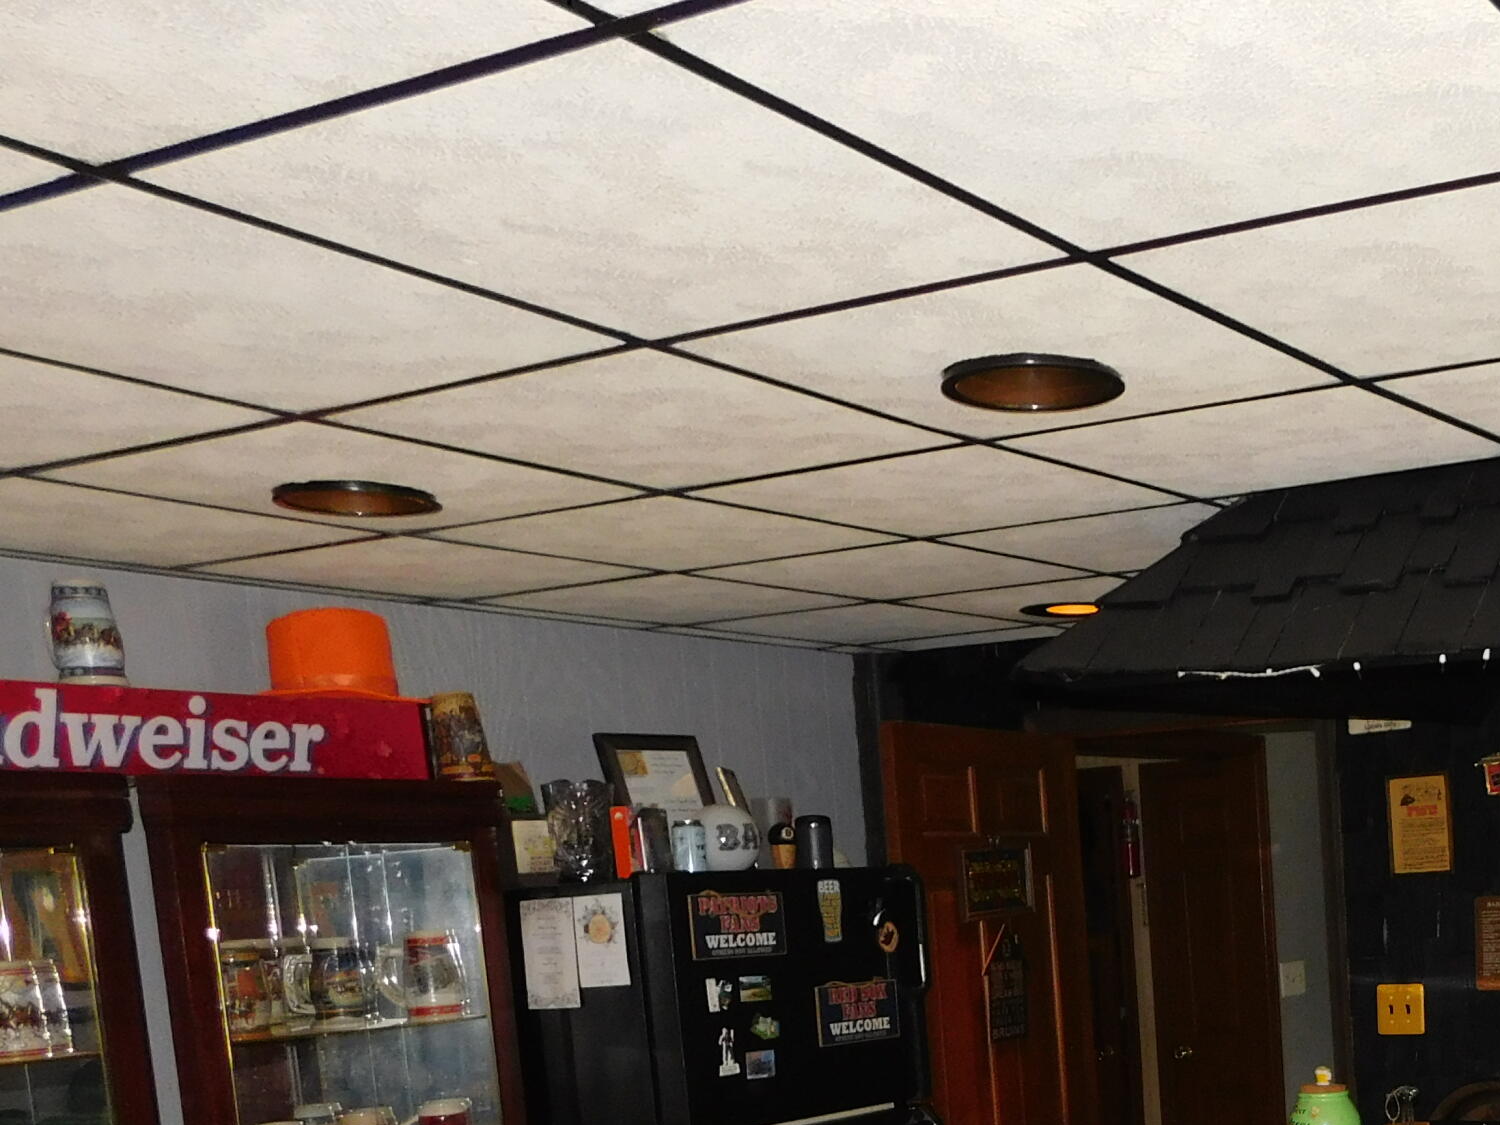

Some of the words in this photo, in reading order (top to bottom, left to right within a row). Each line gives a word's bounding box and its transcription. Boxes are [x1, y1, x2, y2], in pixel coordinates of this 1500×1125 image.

[0, 688, 325, 773] dweiser
[705, 932, 777, 949] WELCOME
[829, 1017, 891, 1036] WELCOME
